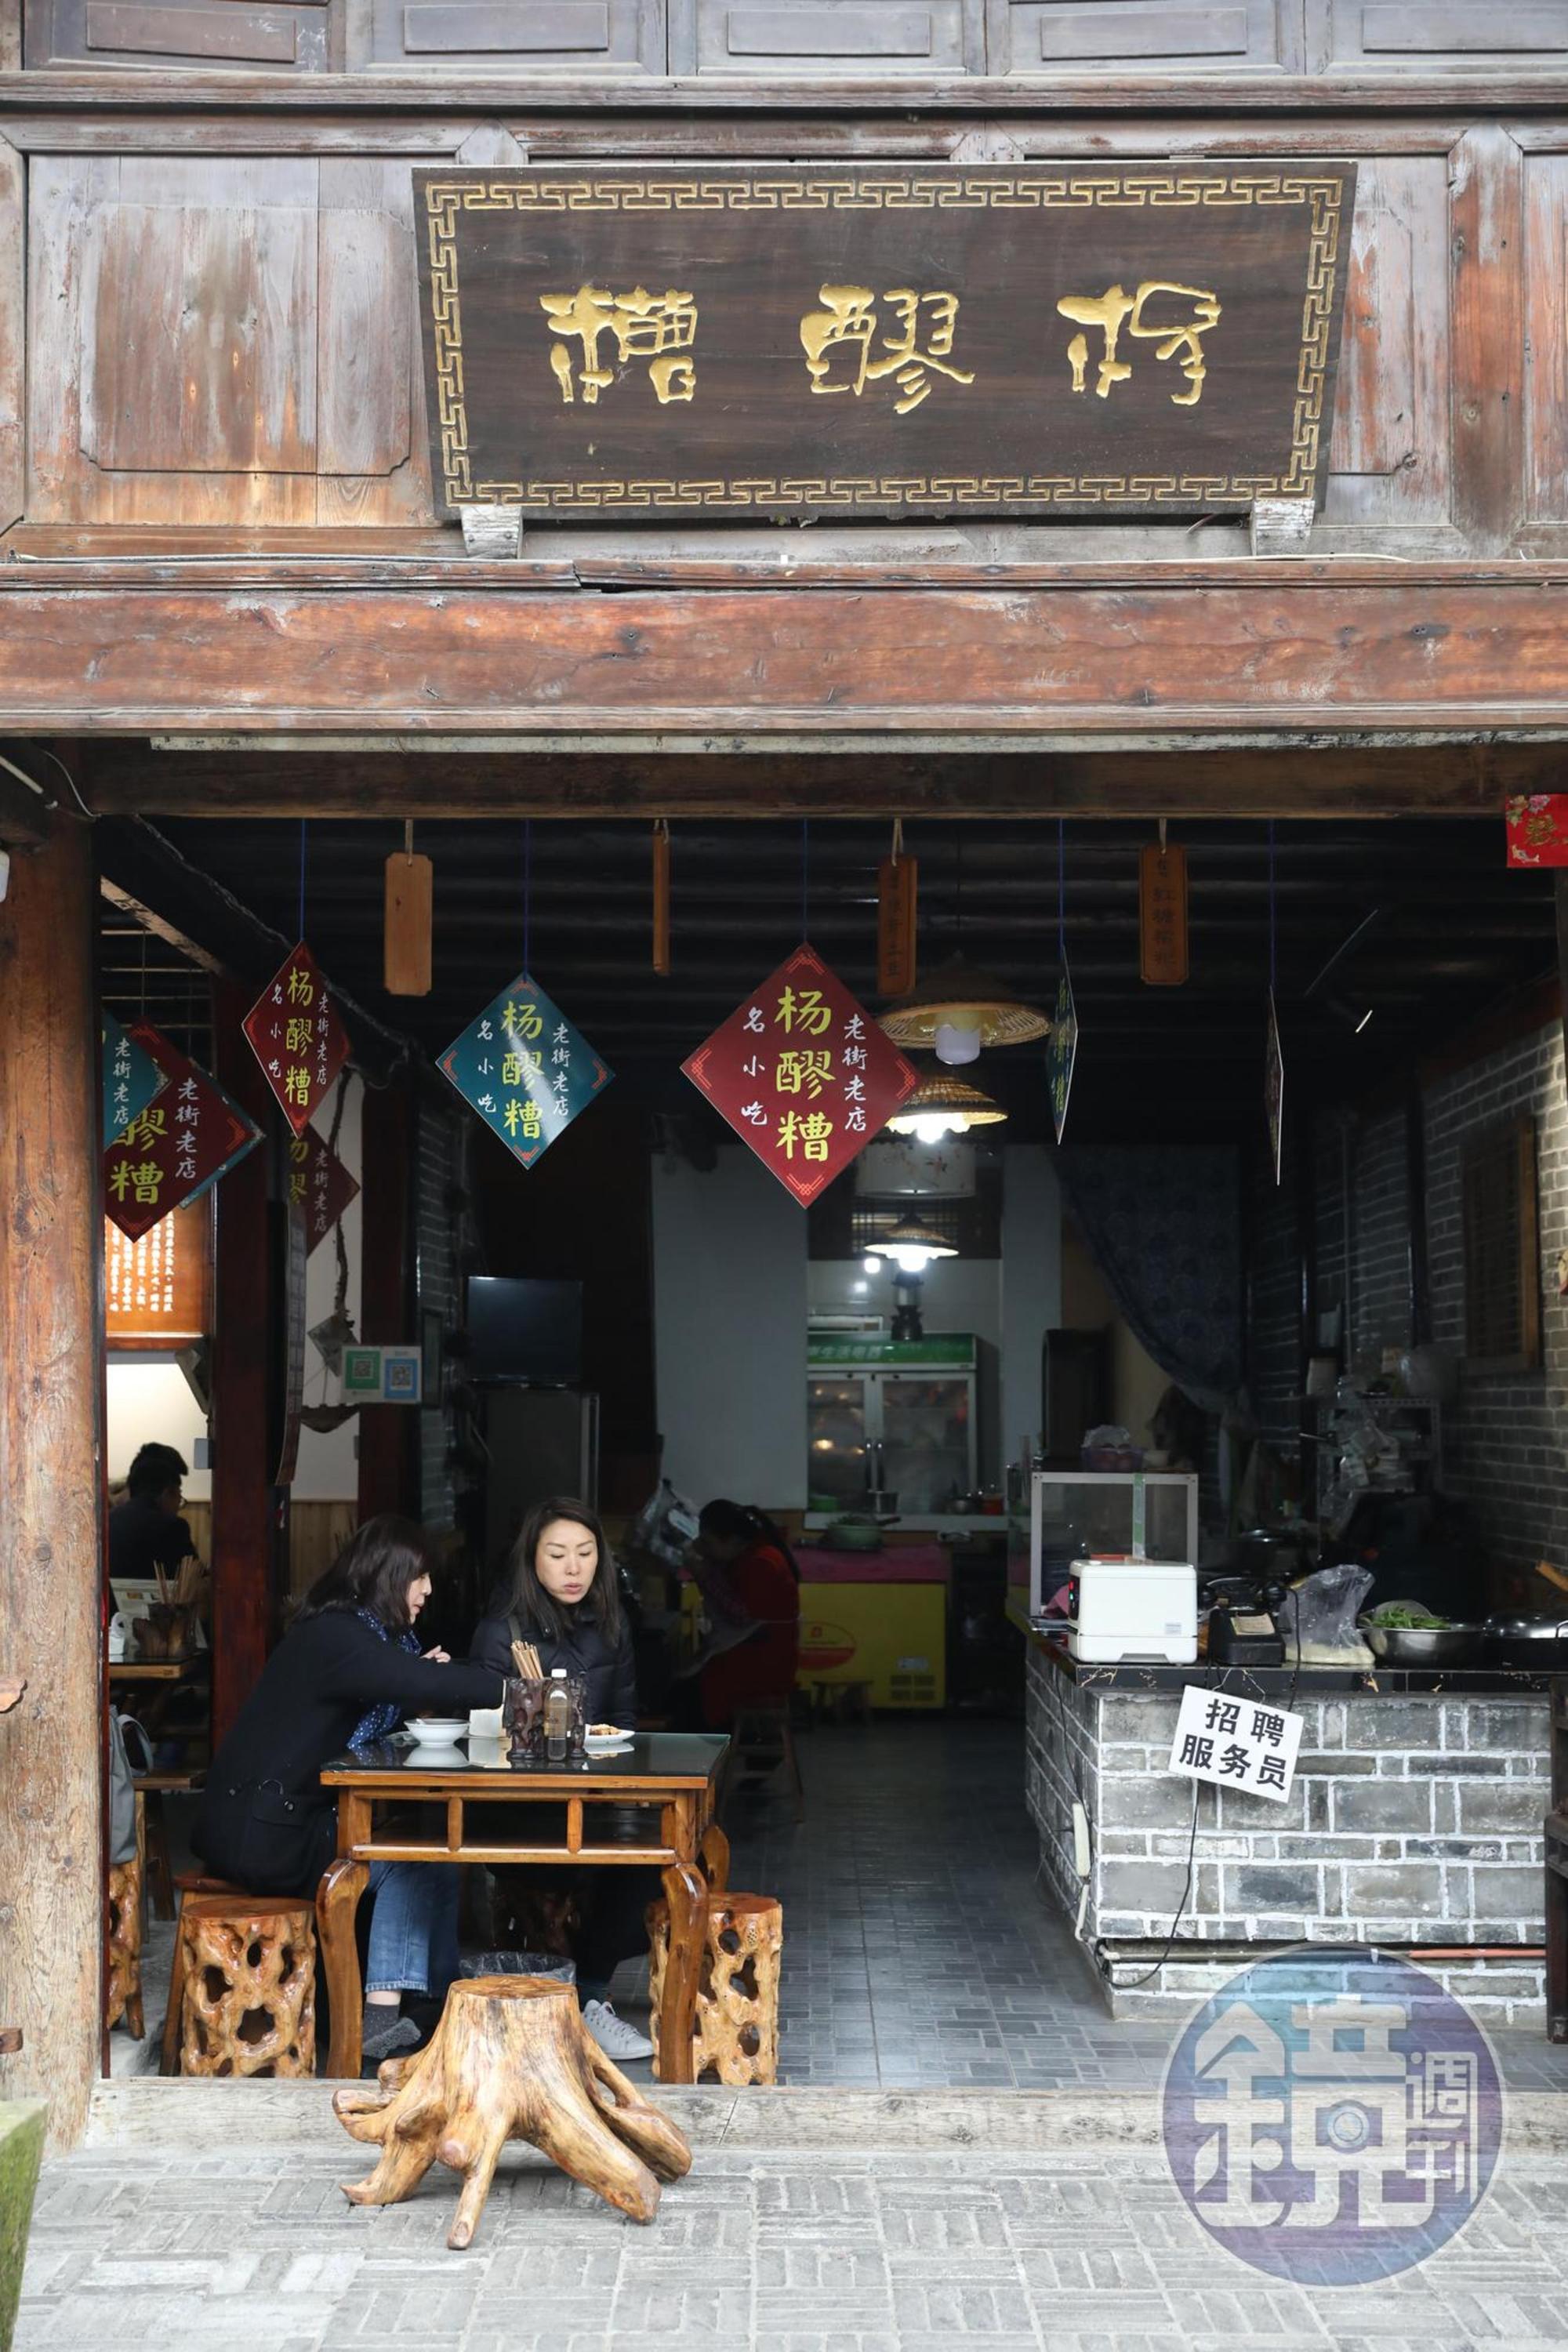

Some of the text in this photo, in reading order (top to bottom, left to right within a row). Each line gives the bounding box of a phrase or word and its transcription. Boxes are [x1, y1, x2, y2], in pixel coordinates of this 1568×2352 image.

[268, 983, 282, 1079] 名小吃
[285, 966, 314, 1106] 杨醪糟
[316, 992, 329, 1086] 老街老店
[477, 1019, 496, 1113] 名小吃
[500, 1000, 545, 1138] 杨醪糟
[551, 1022, 571, 1116] 老街老店
[741, 1007, 768, 1126] 名小吃
[774, 985, 837, 1162] 杨醪糟
[842, 1014, 869, 1132] 老街老店
[113, 1037, 132, 1125] 老街老店
[175, 1077, 201, 1179] 老街老店
[1179, 1733, 1287, 1791] 服务员
[1205, 1698, 1285, 1748] 招聘
